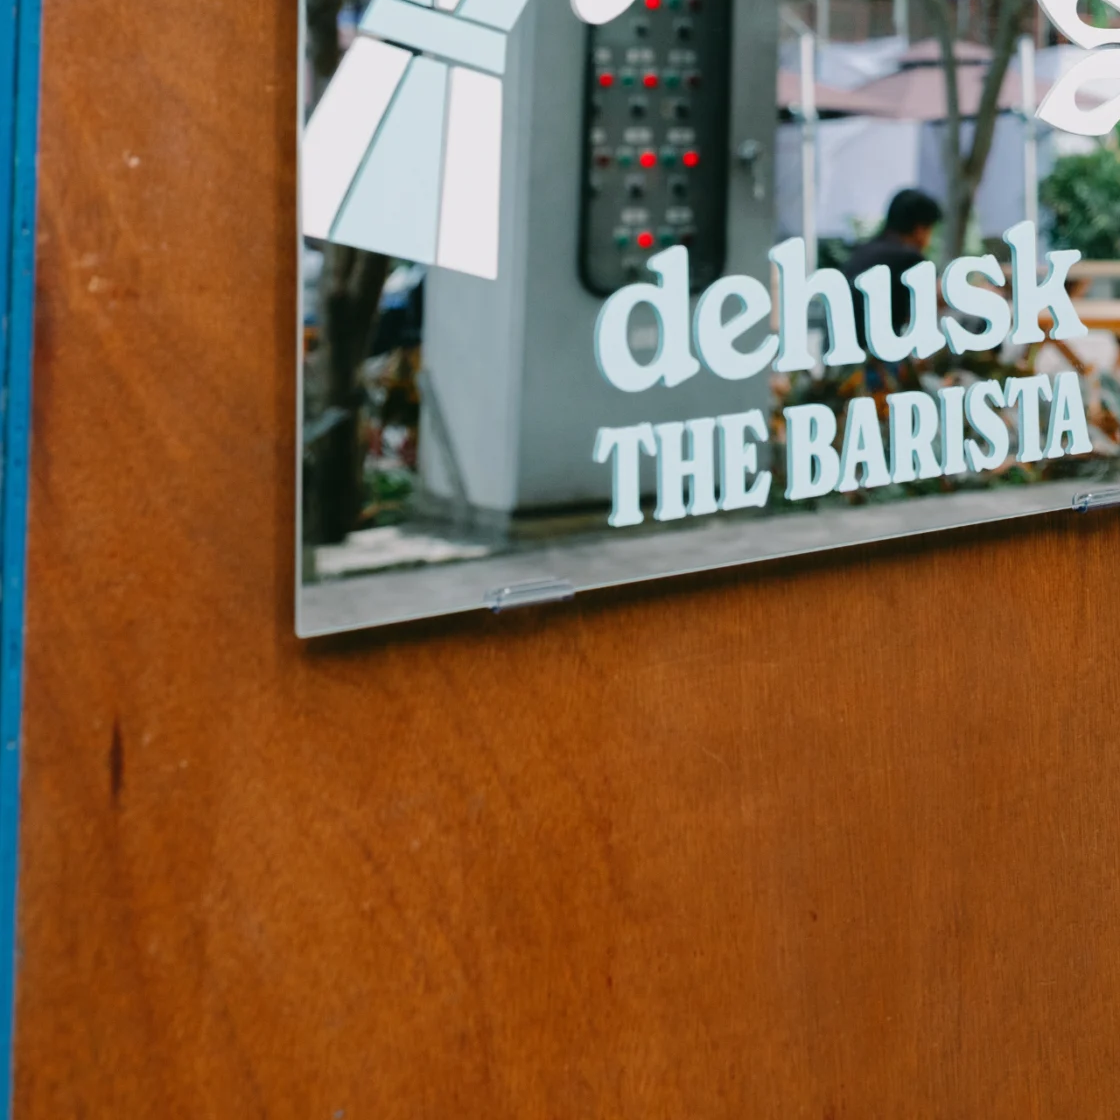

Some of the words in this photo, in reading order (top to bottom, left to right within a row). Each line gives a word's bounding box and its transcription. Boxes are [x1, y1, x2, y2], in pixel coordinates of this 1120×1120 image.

[595, 220, 1088, 392] dehusk
[593, 408, 772, 527] THE
[783, 371, 1093, 501] BARISTA
